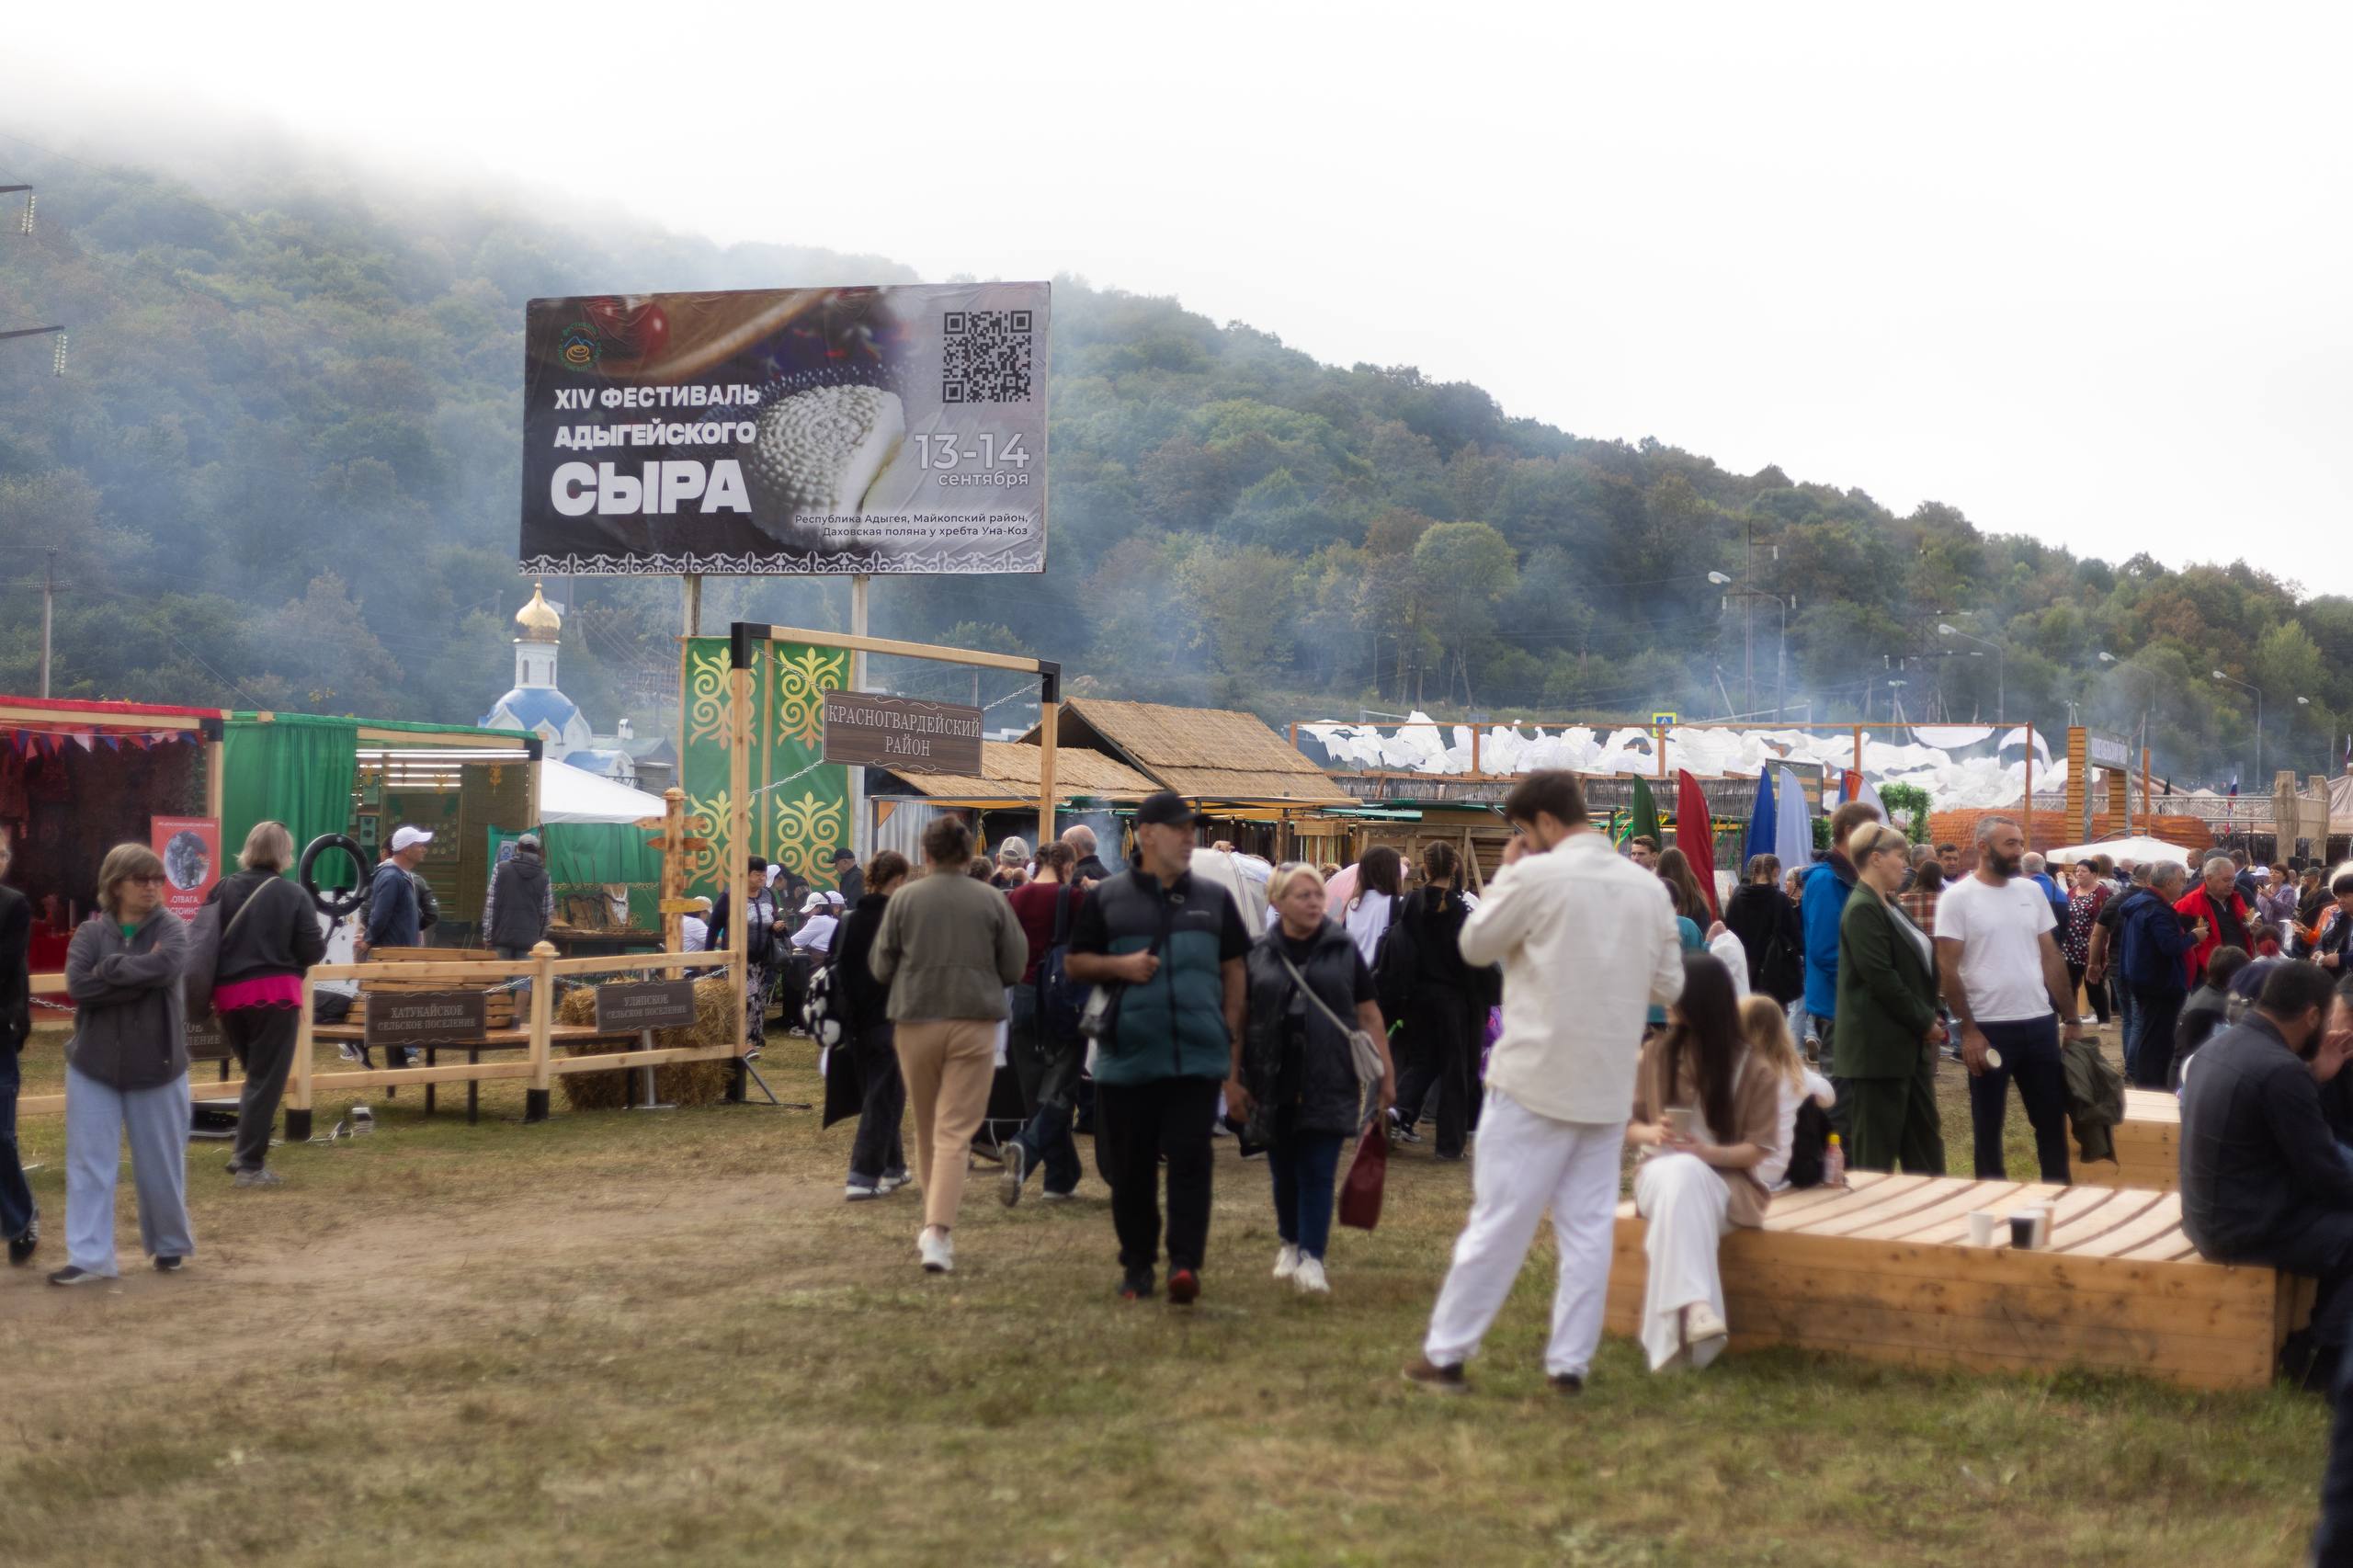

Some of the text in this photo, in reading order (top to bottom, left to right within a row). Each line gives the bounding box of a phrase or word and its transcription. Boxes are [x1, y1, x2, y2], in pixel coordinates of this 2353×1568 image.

[554, 384, 760, 410] XIV ФЕСТИВАЛЬ
[553, 417, 756, 450] АДЫГЕЙСКОГО
[915, 433, 1029, 470] 13-14
[551, 460, 752, 516] СЫРА
[938, 471, 1029, 489] сентября
[795, 513, 1028, 525] Республика Адыгея, Майкопский район,
[823, 528, 881, 537] Даховская
[929, 528, 936, 537] у
[939, 527, 978, 537] хребта
[982, 527, 1028, 536] Уна-Коз
[828, 704, 981, 738] КРАСНОГВАРДЕЙСКИЙ
[884, 733, 930, 756] РАЙОН
[391, 1003, 463, 1018] ХАТУКАЙСКОЕ
[607, 1006, 687, 1019] СЕЛЬСКОЕ ПОСЕЛЕНИЕ
[378, 1017, 476, 1030] СЕЛЬСКОЕ ПОСЕЛЕНИЕ
[185, 1035, 222, 1046] ЛЕНИЕ
